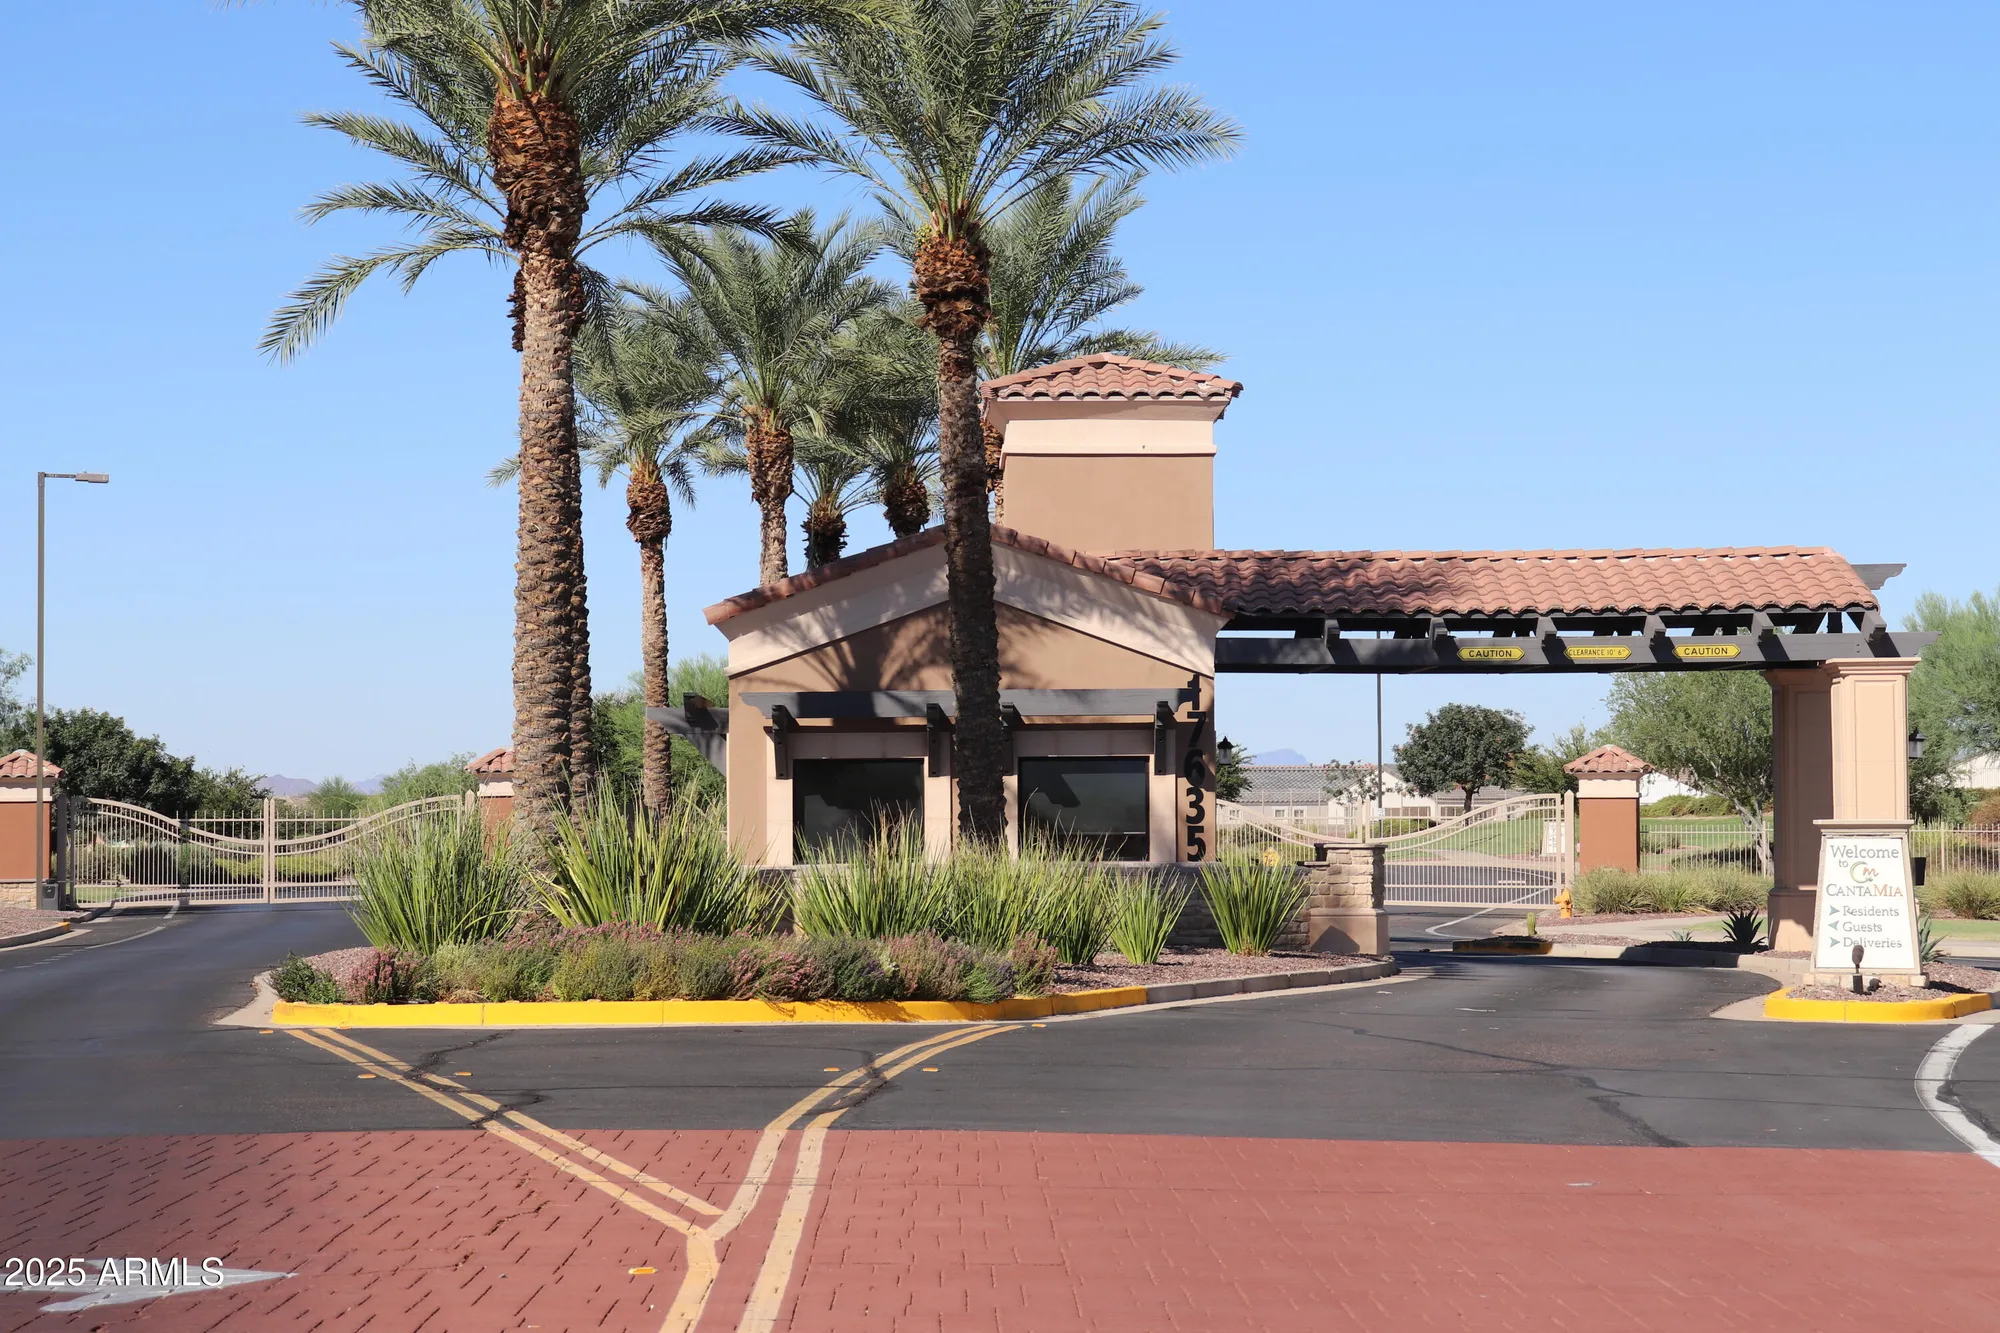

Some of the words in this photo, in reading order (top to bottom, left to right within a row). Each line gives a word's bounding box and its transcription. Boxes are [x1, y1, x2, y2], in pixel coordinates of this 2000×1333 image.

[1468, 649, 1513, 658] CAUTION
[1683, 646, 1729, 656] CAUTION
[1184, 673, 1207, 862] 17635
[1830, 845, 1900, 859] Welcome
[1838, 859, 1849, 868] to
[1842, 905, 1900, 917] Residents
[1842, 921, 1883, 932] Guests
[1842, 936, 1903, 948] Deliveries
